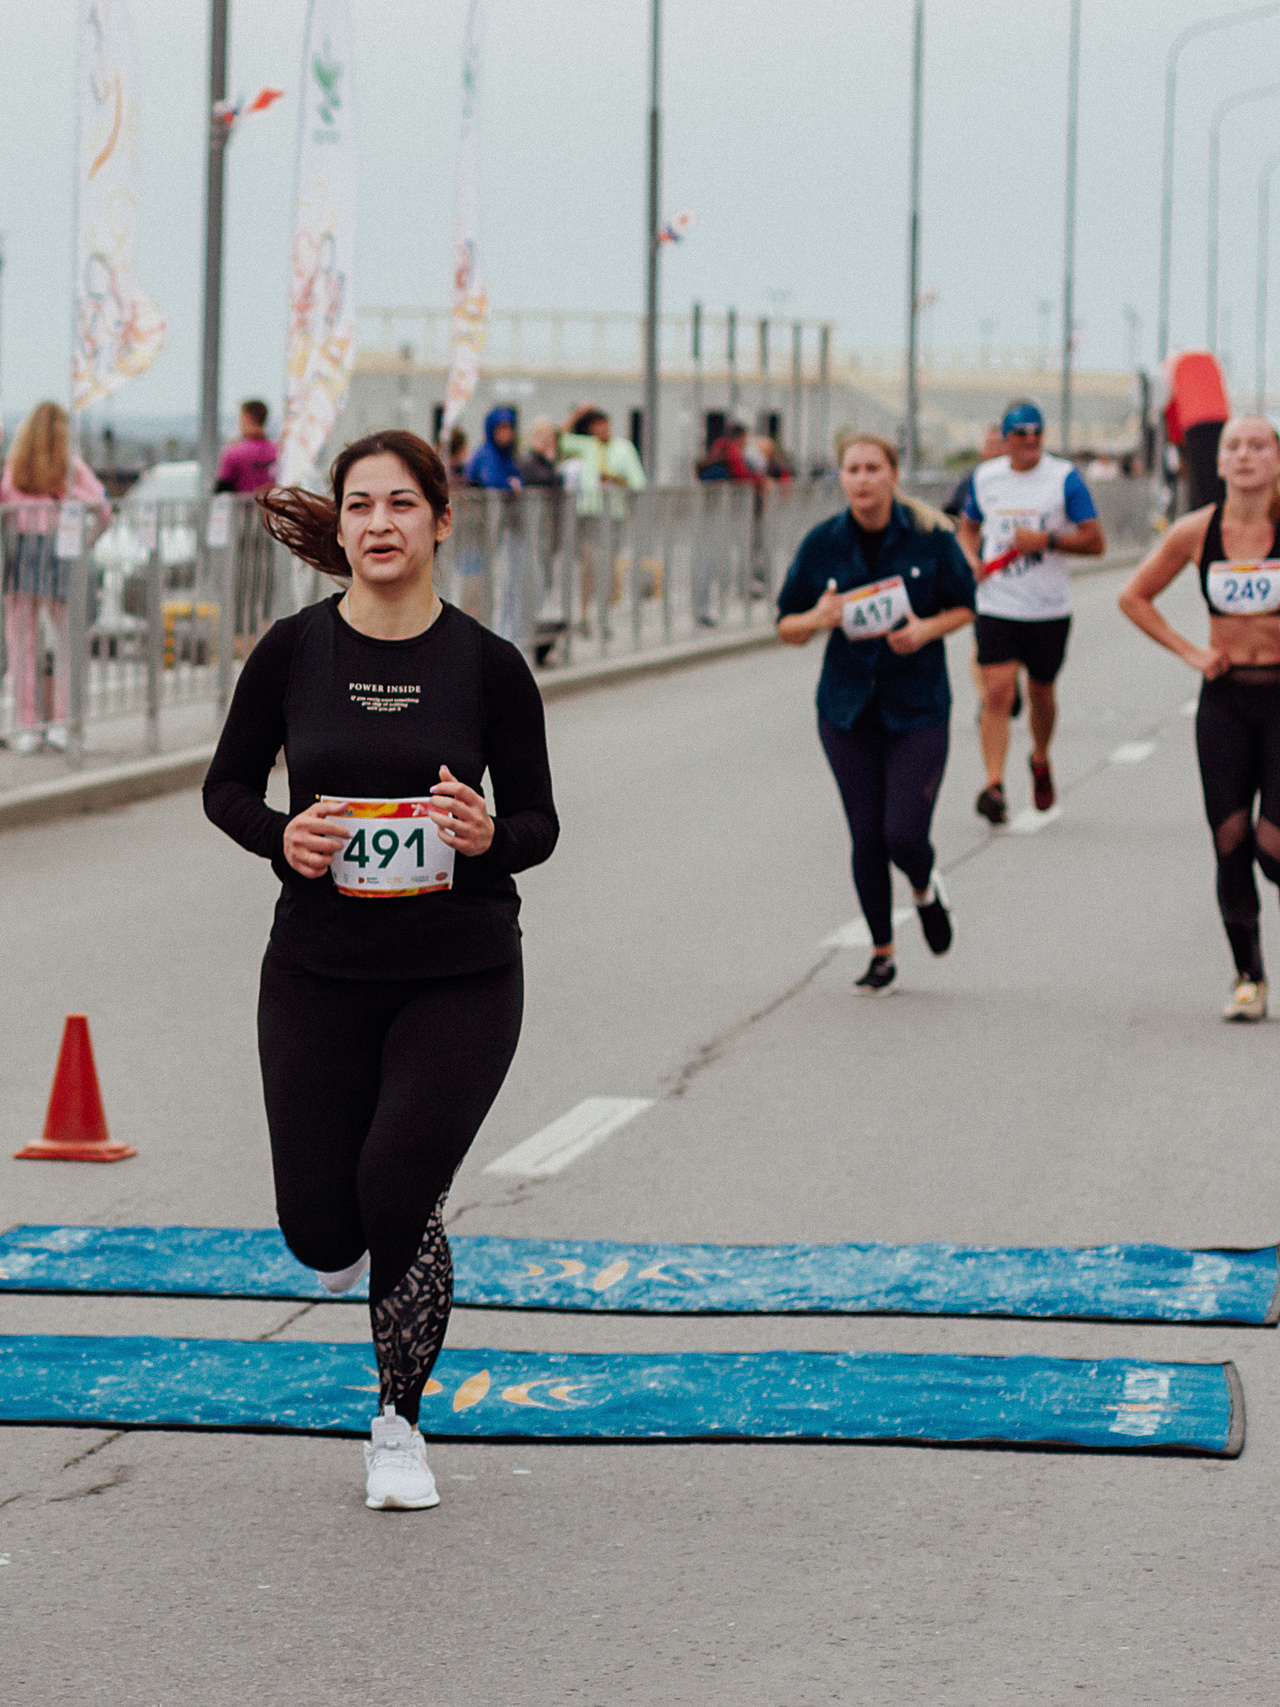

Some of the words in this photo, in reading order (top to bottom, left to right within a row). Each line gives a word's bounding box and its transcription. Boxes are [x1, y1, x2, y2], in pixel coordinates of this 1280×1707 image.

[1224, 578, 1270, 601] 249
[853, 596, 892, 626] 417
[349, 682, 384, 693] POWER
[387, 685, 421, 693] INSIDE
[343, 828, 424, 869] 491
